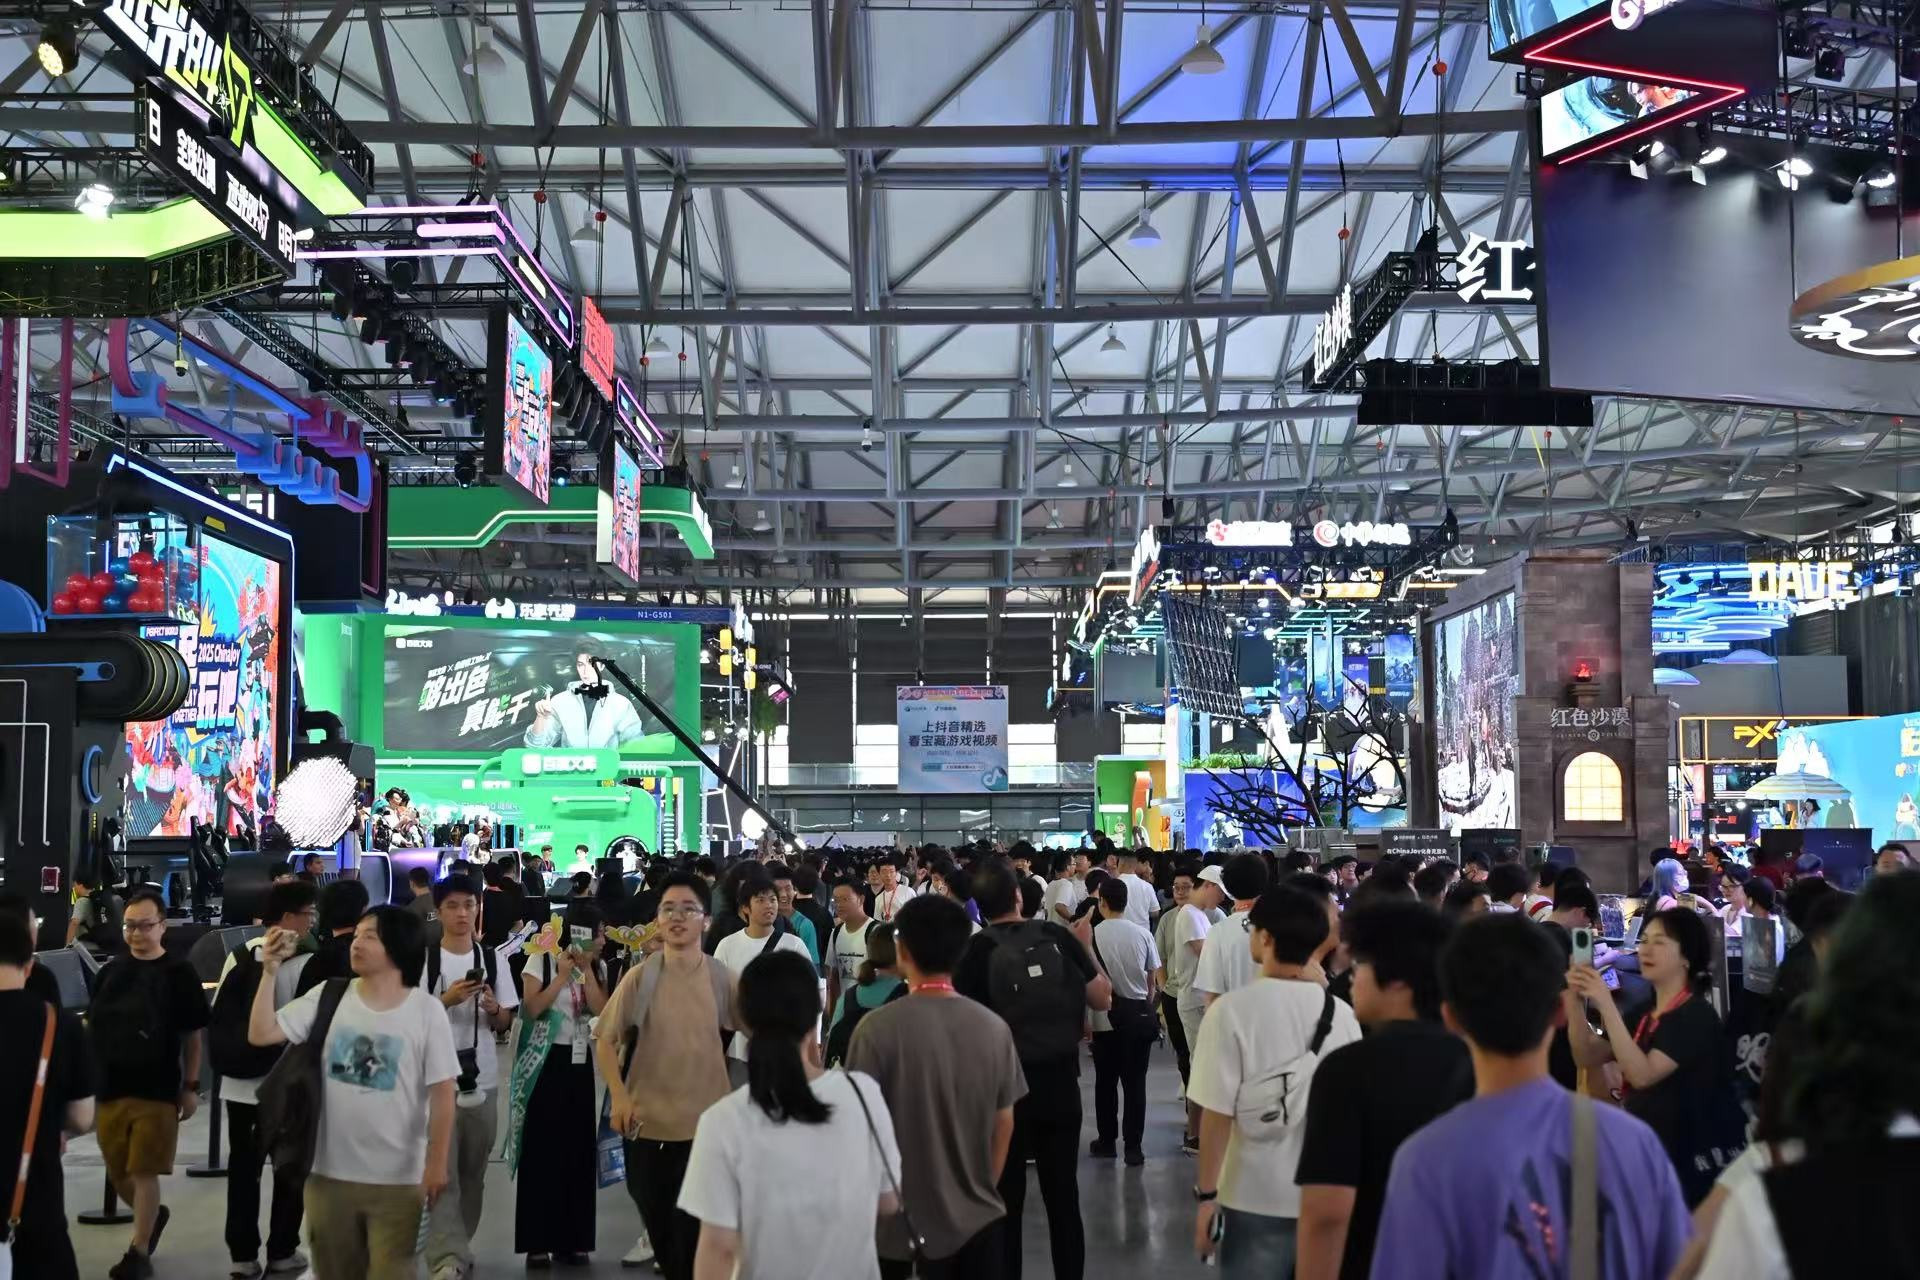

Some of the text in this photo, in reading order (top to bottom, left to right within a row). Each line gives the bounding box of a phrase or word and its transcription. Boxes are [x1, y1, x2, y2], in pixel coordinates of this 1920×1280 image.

[1456, 231, 1536, 303] 红
[1314, 282, 1353, 384] 红色沙漠
[1747, 561, 1854, 600] DAVE
[637, 610, 674, 620] N1-G501
[198, 642, 241, 667] 2025 ChinaJoy
[418, 664, 491, 711] 够出色
[921, 720, 986, 733] 上抖音精选
[1550, 707, 1631, 728] 红色沙漠
[908, 734, 998, 748] 看宝藏游戏视频
[1733, 720, 1778, 749] PX
